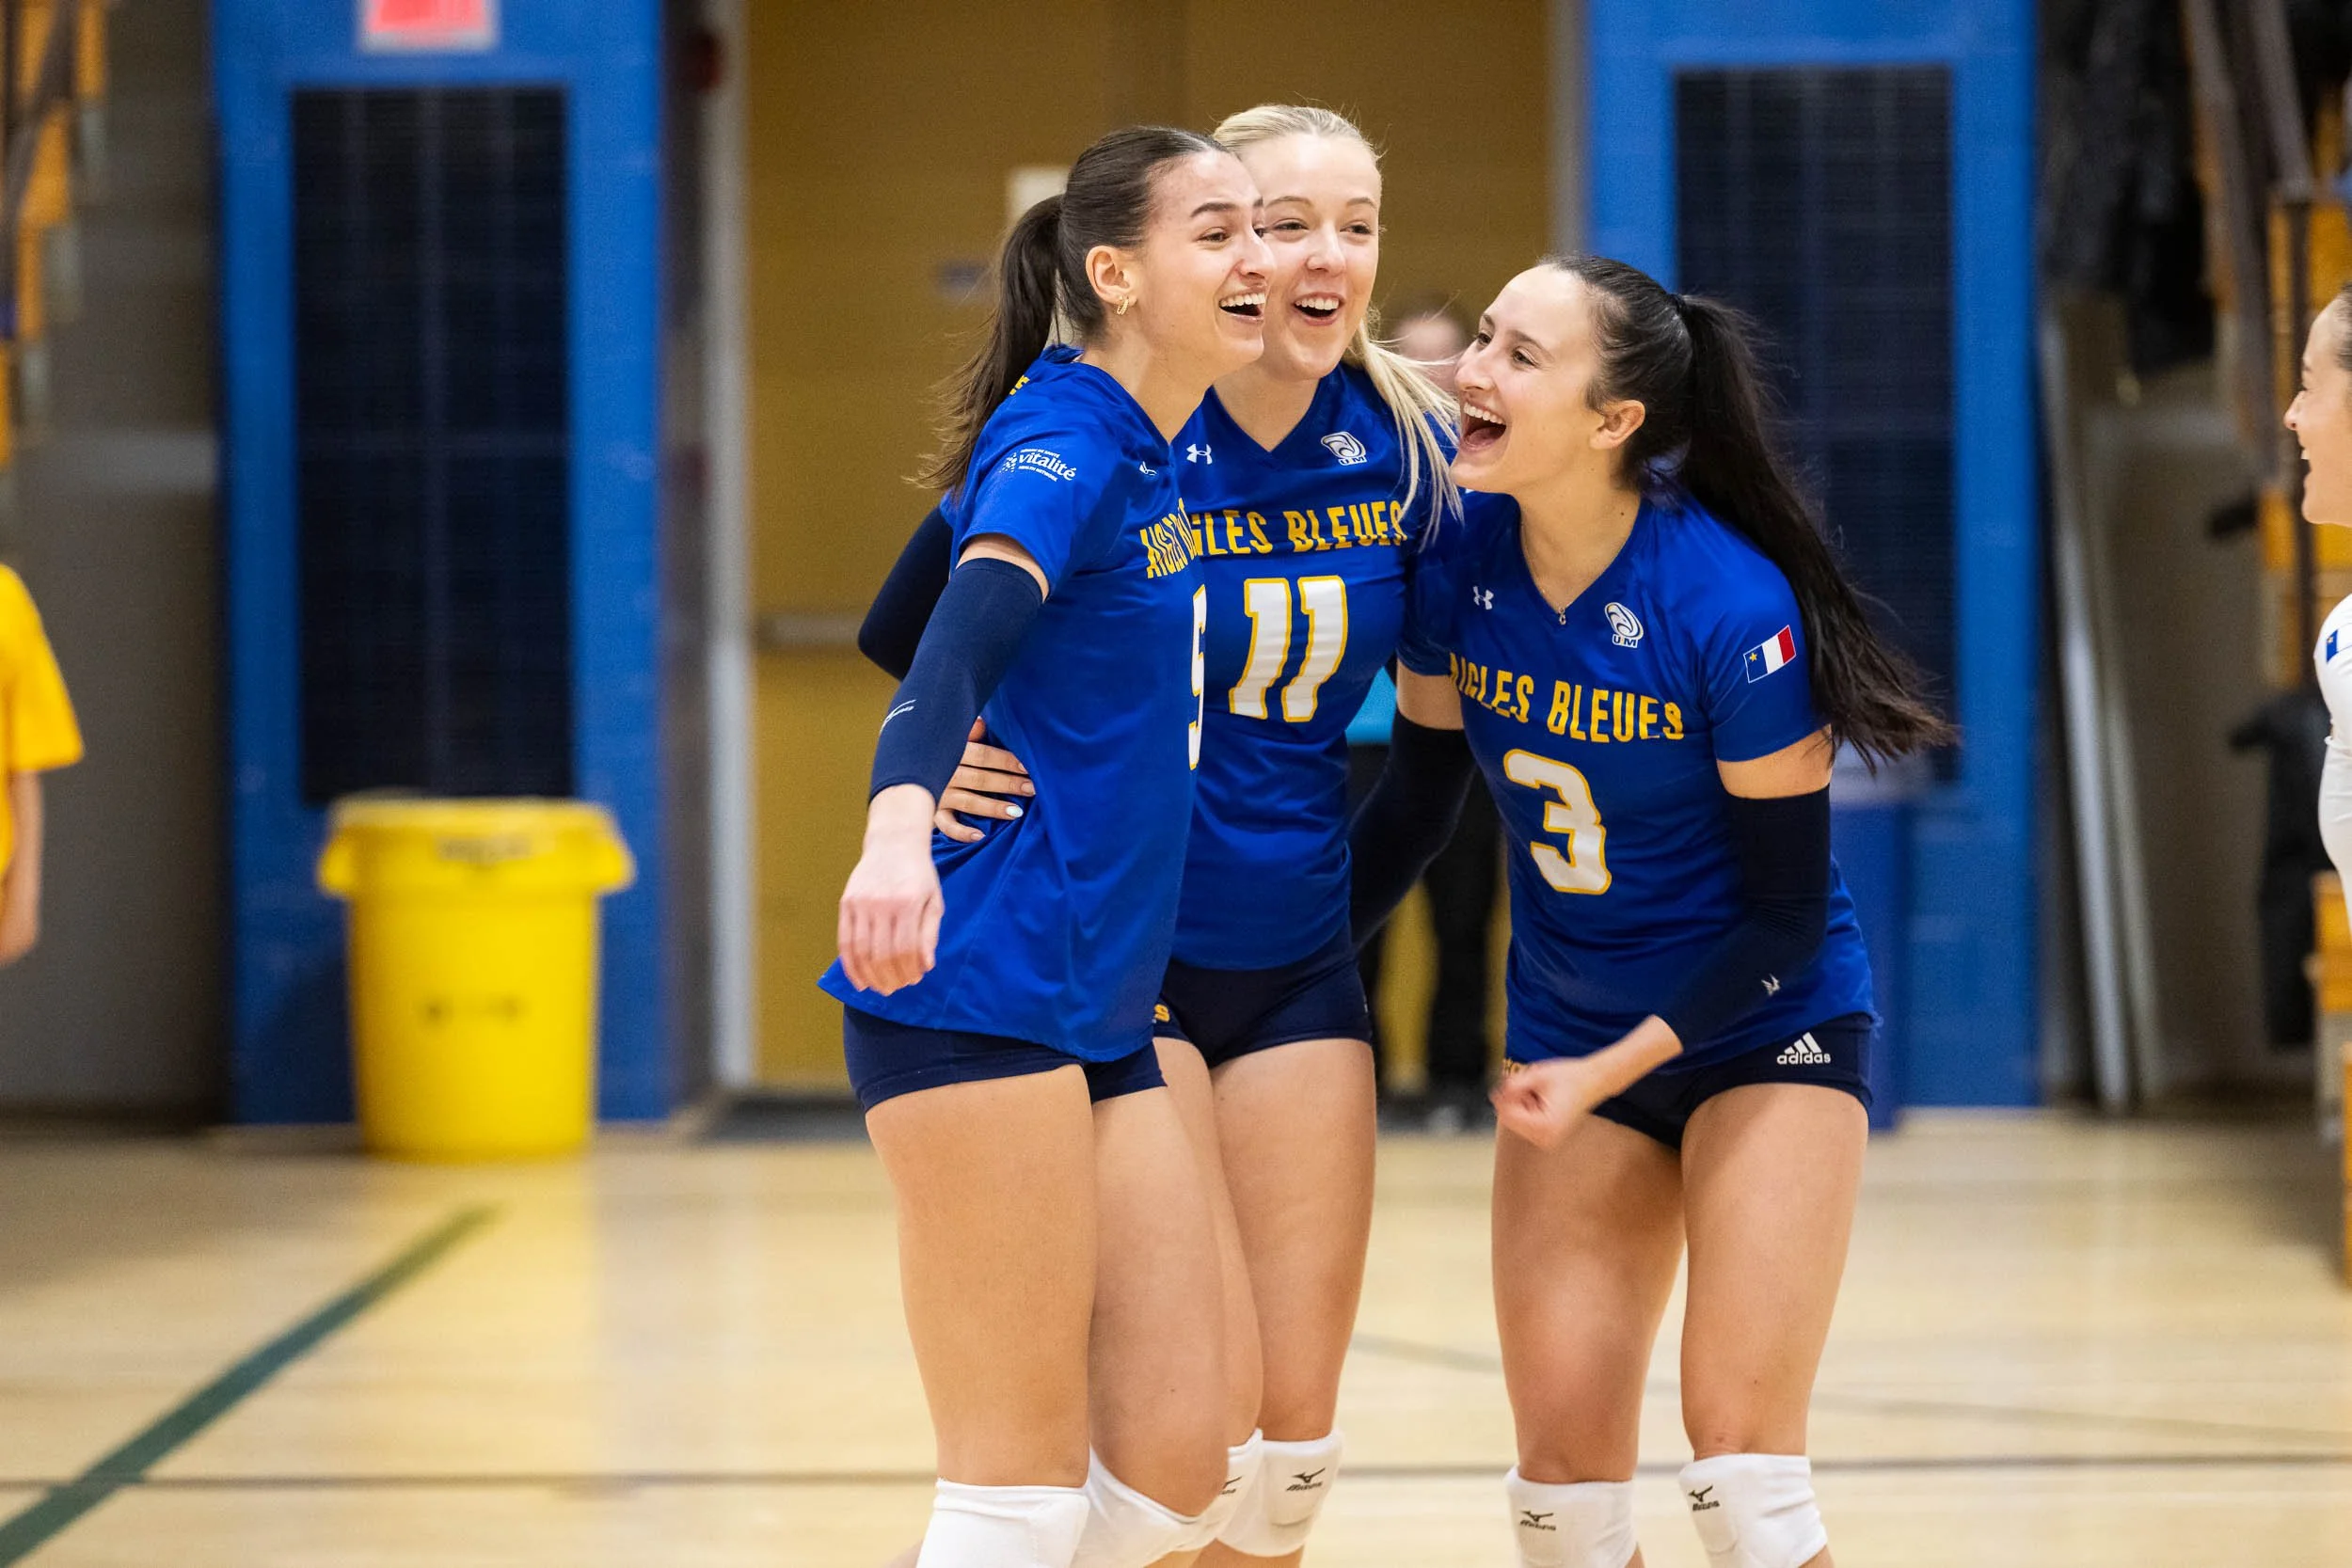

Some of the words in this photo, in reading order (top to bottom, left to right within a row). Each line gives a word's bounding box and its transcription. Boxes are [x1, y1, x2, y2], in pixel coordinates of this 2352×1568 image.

[1019, 452, 1076, 481] vitalité
[1283, 500, 1407, 553] BLEUES
[1229, 575, 1349, 722] 11
[1547, 679, 1685, 743] BLEUES
[1502, 749, 1613, 895] 3
[1776, 1051, 1832, 1065] adidas
